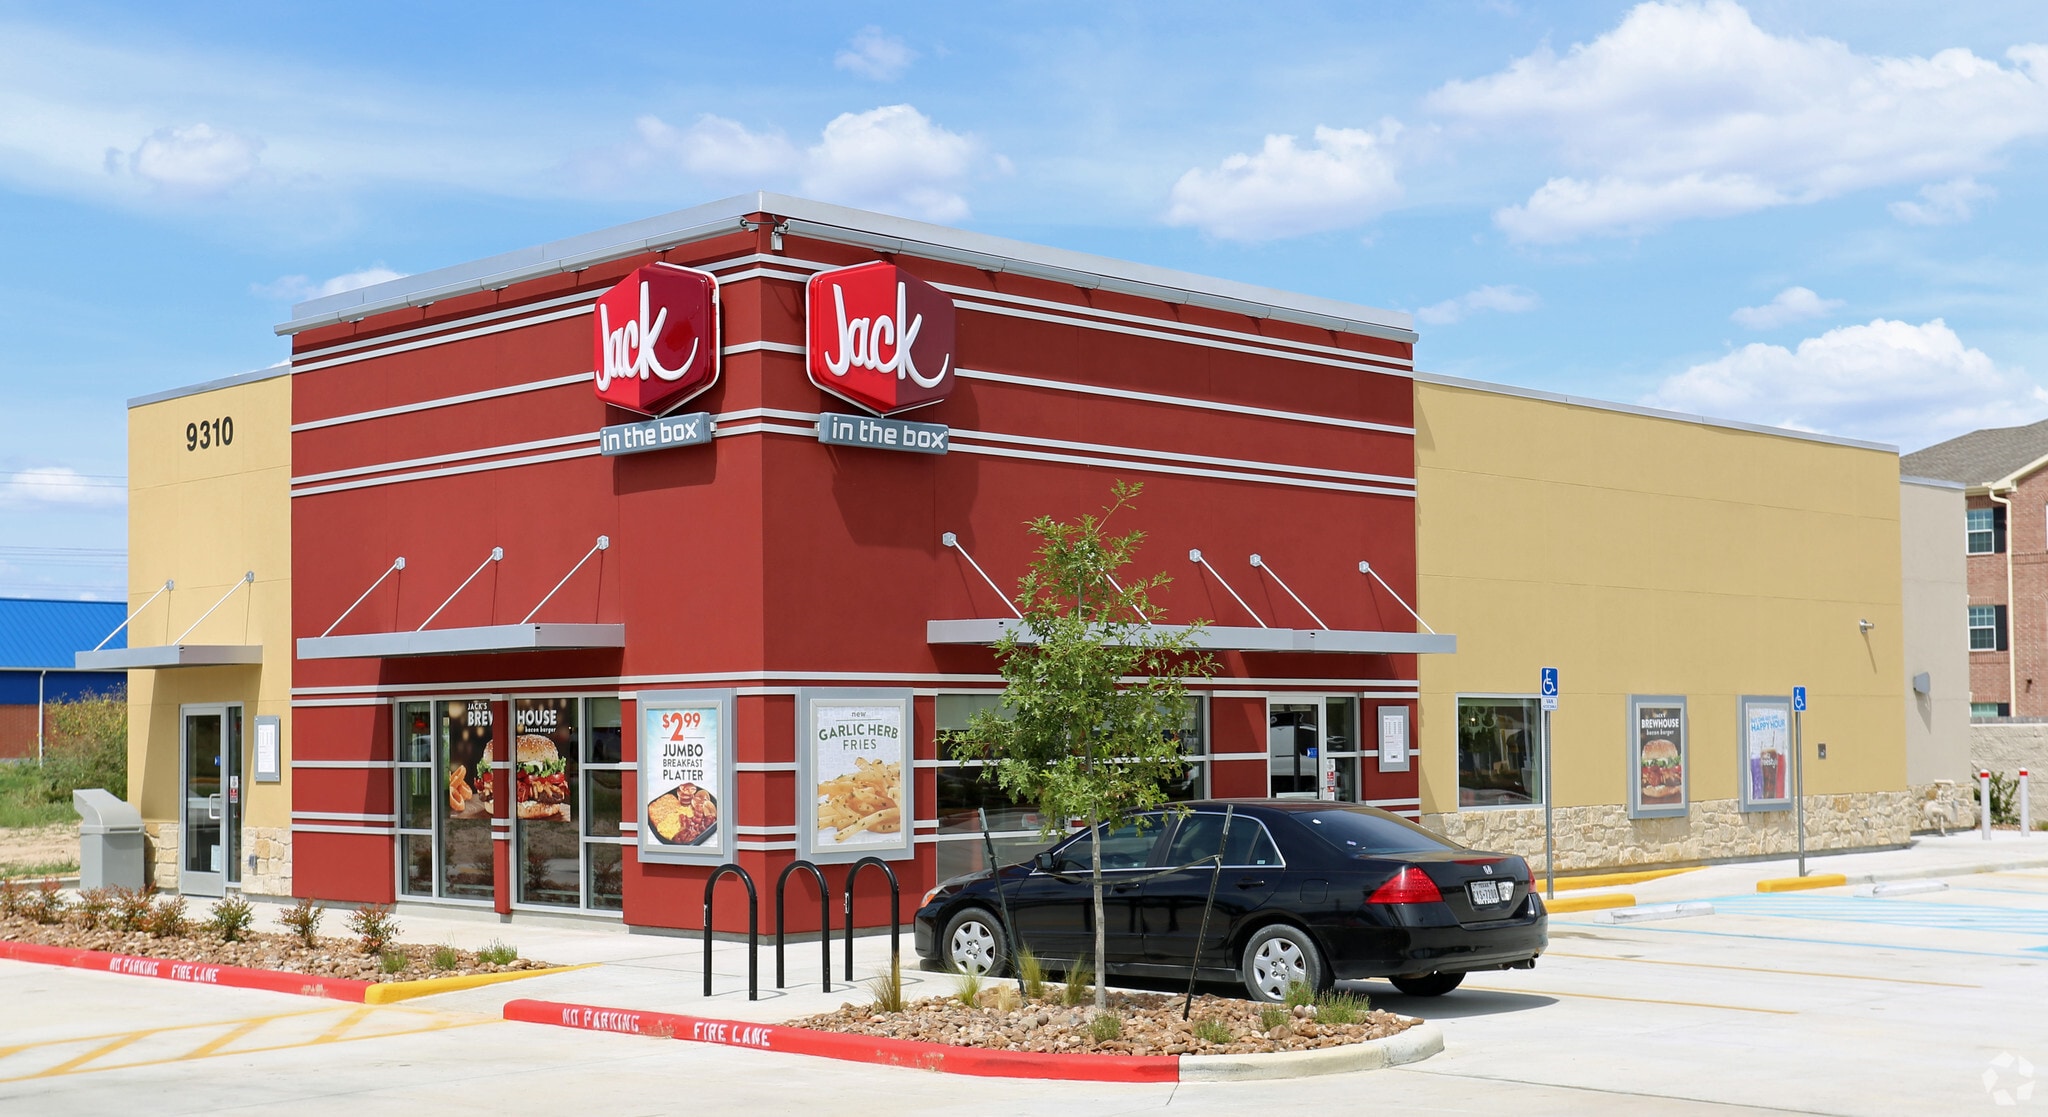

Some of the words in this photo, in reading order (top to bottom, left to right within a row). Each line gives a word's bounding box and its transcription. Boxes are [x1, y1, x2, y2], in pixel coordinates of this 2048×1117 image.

[595, 280, 699, 392] Jack
[824, 281, 951, 389] Jack
[186, 415, 234, 452] 9310
[602, 429, 620, 451] in
[624, 426, 657, 449] the
[833, 416, 853, 441] in
[859, 420, 898, 445] the
[467, 702, 488, 711] JACK'S
[818, 723, 865, 741] GARLIC
[868, 723, 898, 739] HERB
[1641, 718, 1679, 729] BREWHOUSE
[1751, 721, 1770, 732] HAPPY
[663, 744, 704, 757] JUMBO
[843, 738, 877, 750] FRIES
[663, 758, 703, 768] BREAKFAST
[663, 769, 703, 781] PLATTER
[109, 957, 122, 971] NO
[123, 958, 160, 976] PARKING
[171, 964, 193, 980] FIRE
[193, 967, 220, 982] LANE
[562, 1008, 579, 1026] NO
[583, 1008, 640, 1033] PARKING
[694, 1021, 728, 1042] FIRE
[732, 1025, 773, 1047] LANE
